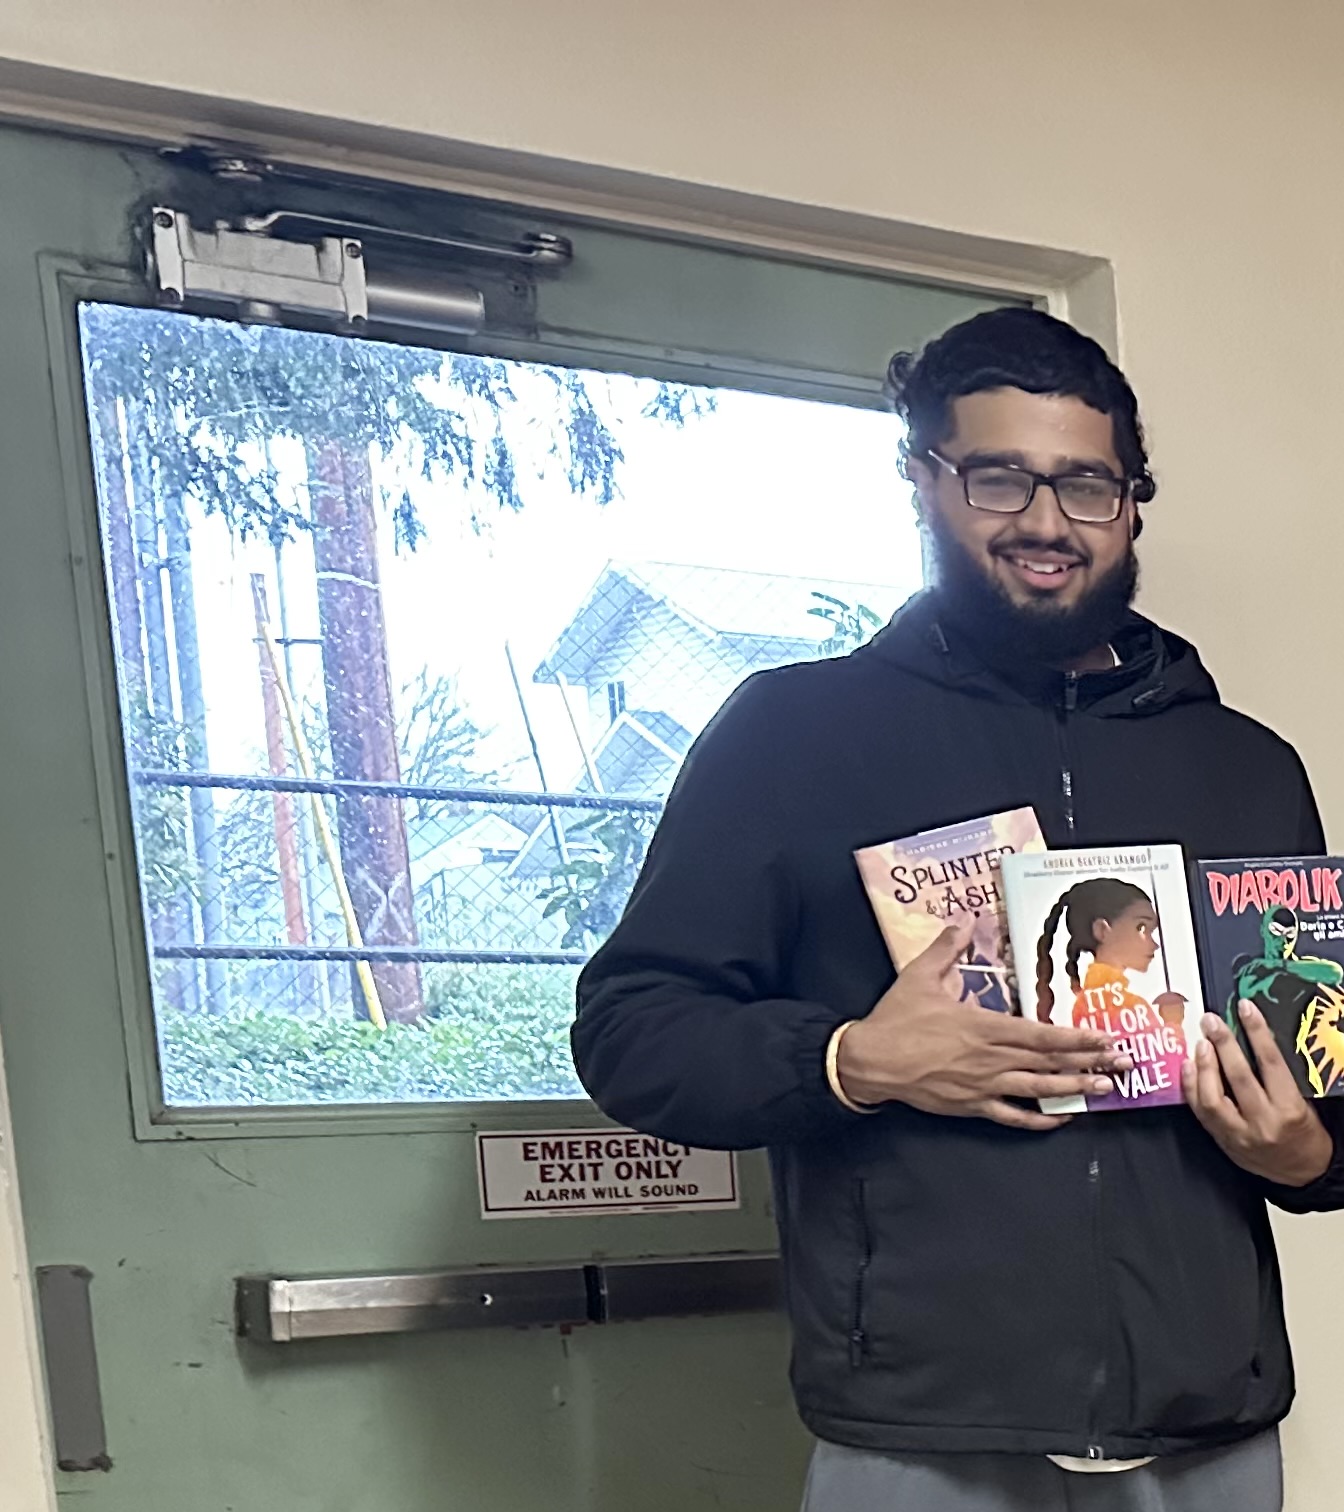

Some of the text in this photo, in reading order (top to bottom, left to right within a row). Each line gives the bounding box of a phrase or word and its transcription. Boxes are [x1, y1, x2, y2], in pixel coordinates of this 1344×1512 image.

[1206, 867, 1343, 916] DIABOLIK
[1084, 981, 1124, 1013] IT'S
[1120, 1004, 1151, 1033] OR
[1113, 1061, 1172, 1099] VALE
[539, 1159, 683, 1183] EXIT ONLY
[524, 1183, 700, 1202] ALARM WILL SOUND
